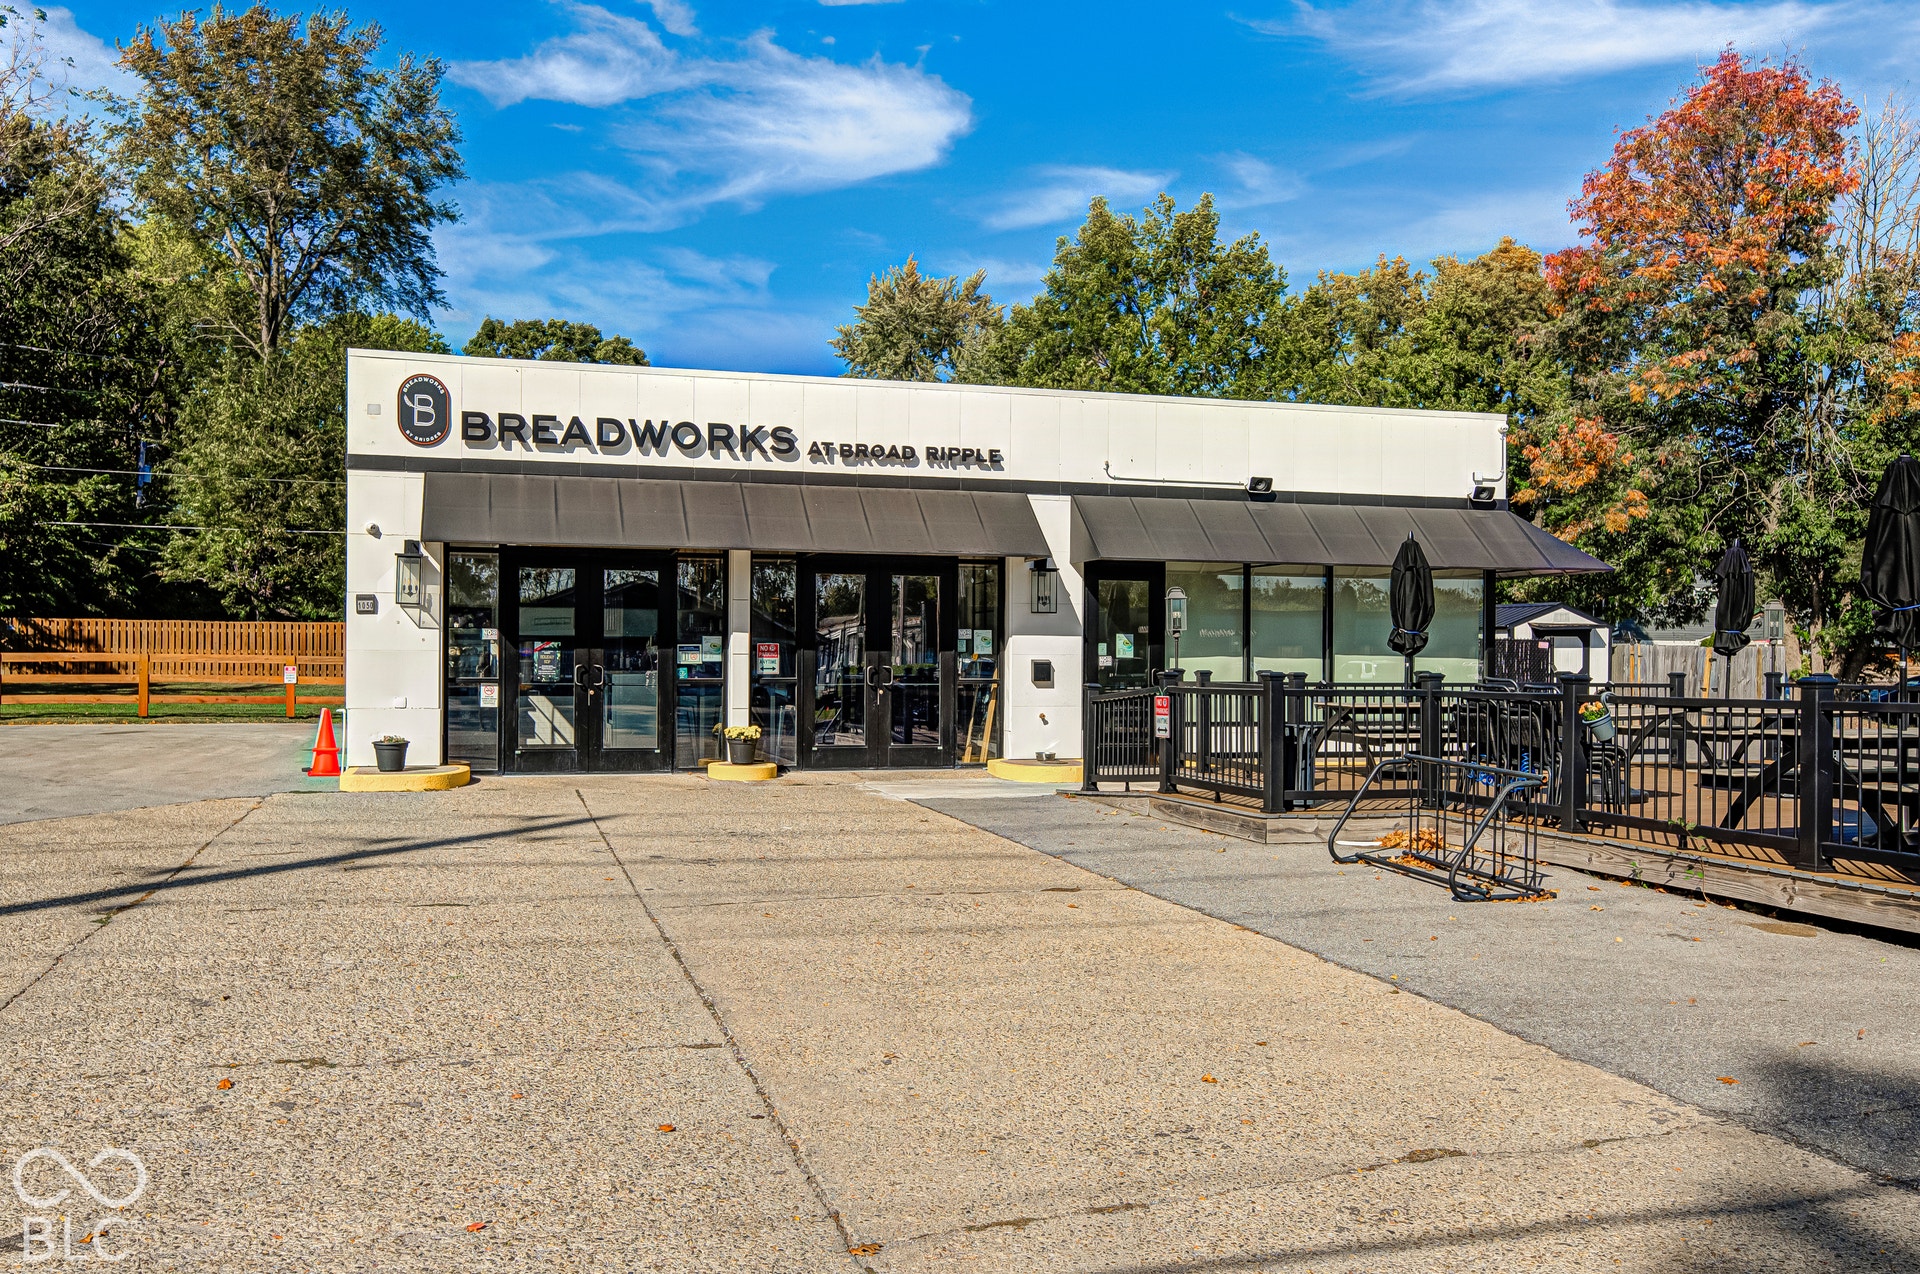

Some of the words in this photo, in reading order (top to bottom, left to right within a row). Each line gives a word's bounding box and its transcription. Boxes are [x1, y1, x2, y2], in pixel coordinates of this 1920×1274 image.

[403, 377, 445, 394] BREADWORKS
[413, 394, 436, 427] B
[461, 410, 796, 456] BREADWORKS
[807, 441, 834, 457] AT
[839, 443, 916, 460] BROAD
[925, 446, 1001, 464] RIPPLE
[358, 601, 374, 610] 1050
